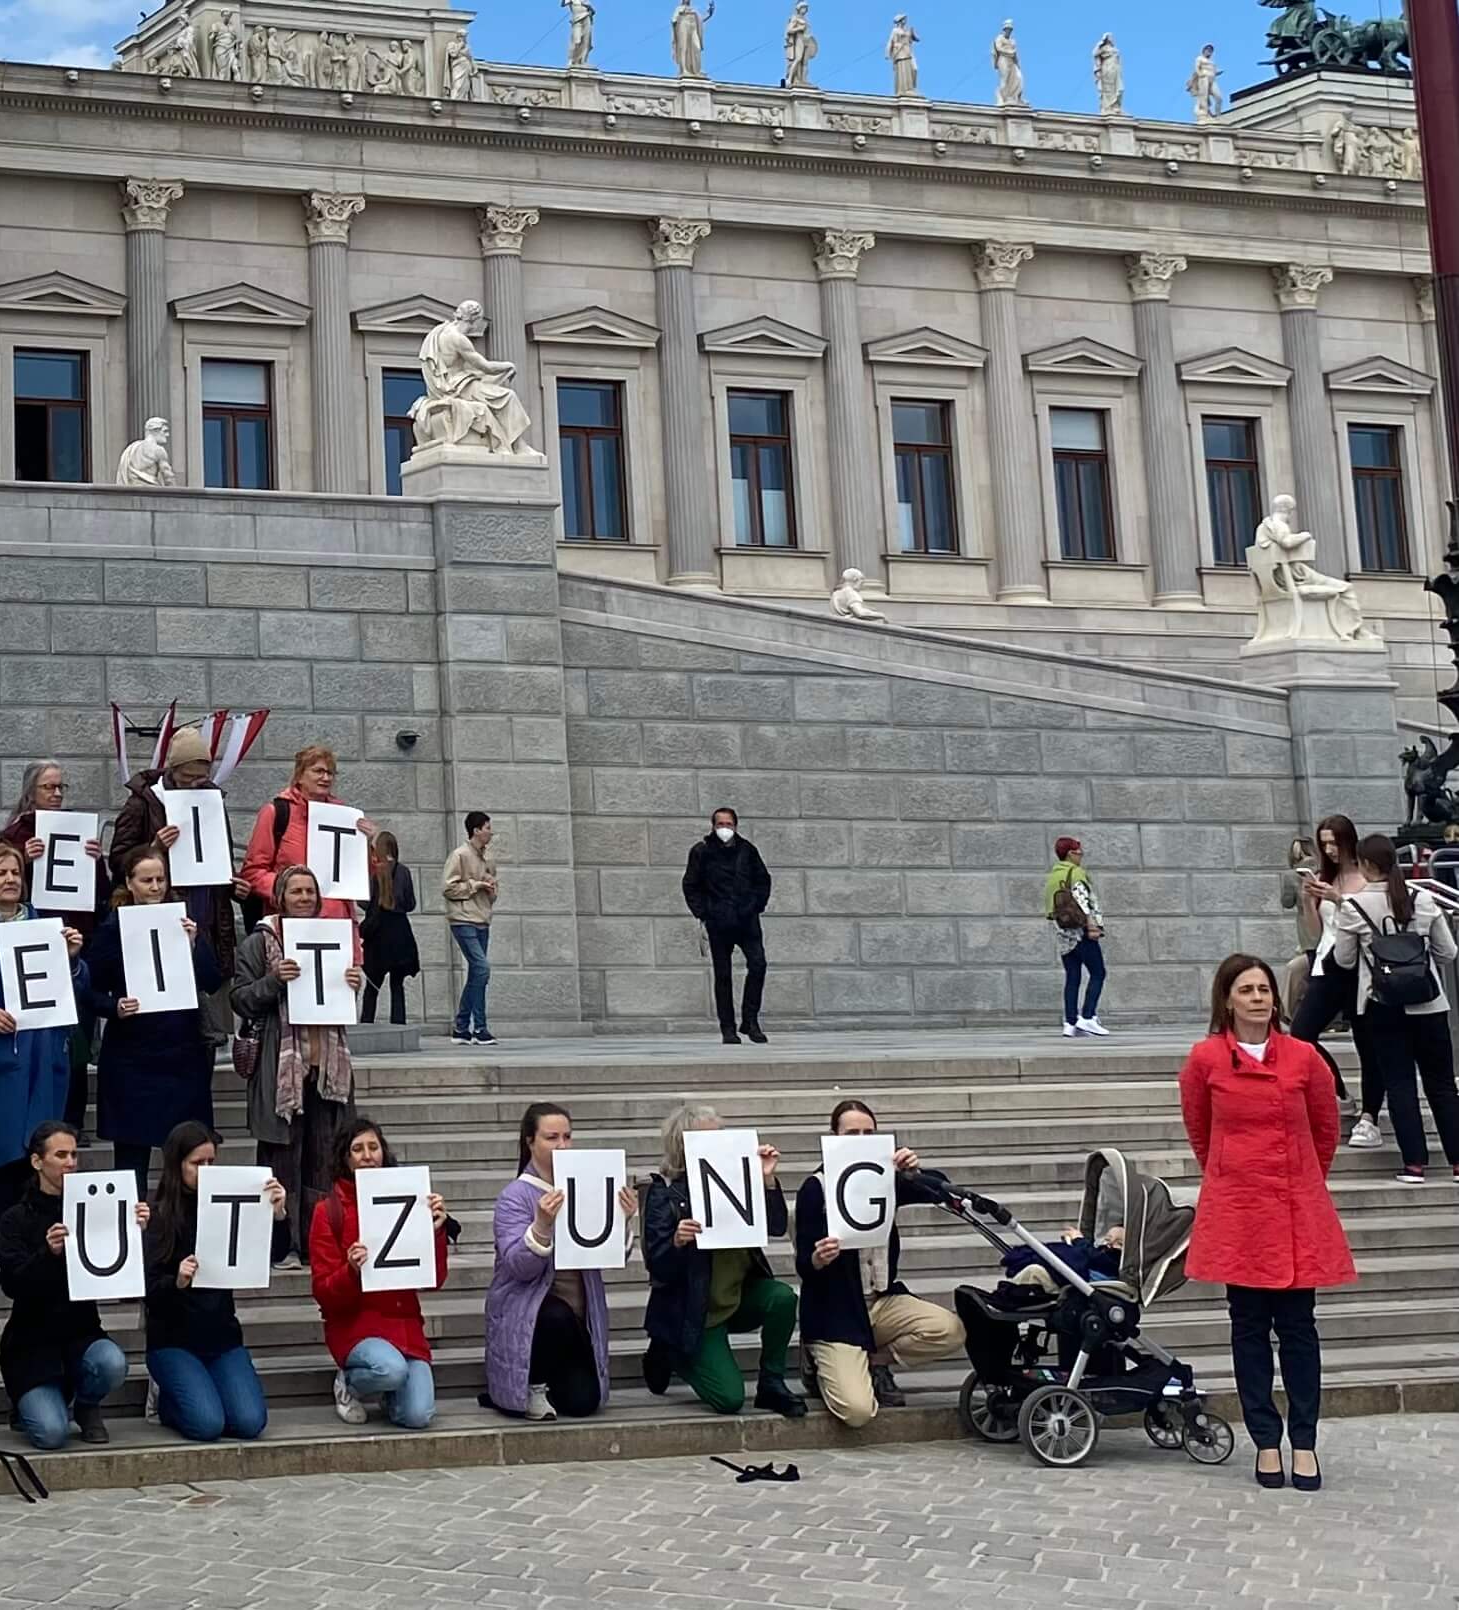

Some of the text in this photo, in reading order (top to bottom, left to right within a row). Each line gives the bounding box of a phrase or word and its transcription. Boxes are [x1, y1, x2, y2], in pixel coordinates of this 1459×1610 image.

[45, 833, 80, 891] E
[192, 807, 202, 862] I
[318, 823, 357, 882] T
[14, 944, 56, 1010] E
[151, 929, 165, 991] I
[296, 943, 340, 1005] T
[567, 1177, 614, 1248] U
[698, 1157, 754, 1229] N
[837, 1162, 886, 1231] G
[76, 1183, 128, 1276] Ü
[211, 1195, 261, 1266] T
[373, 1195, 420, 1268] Z
